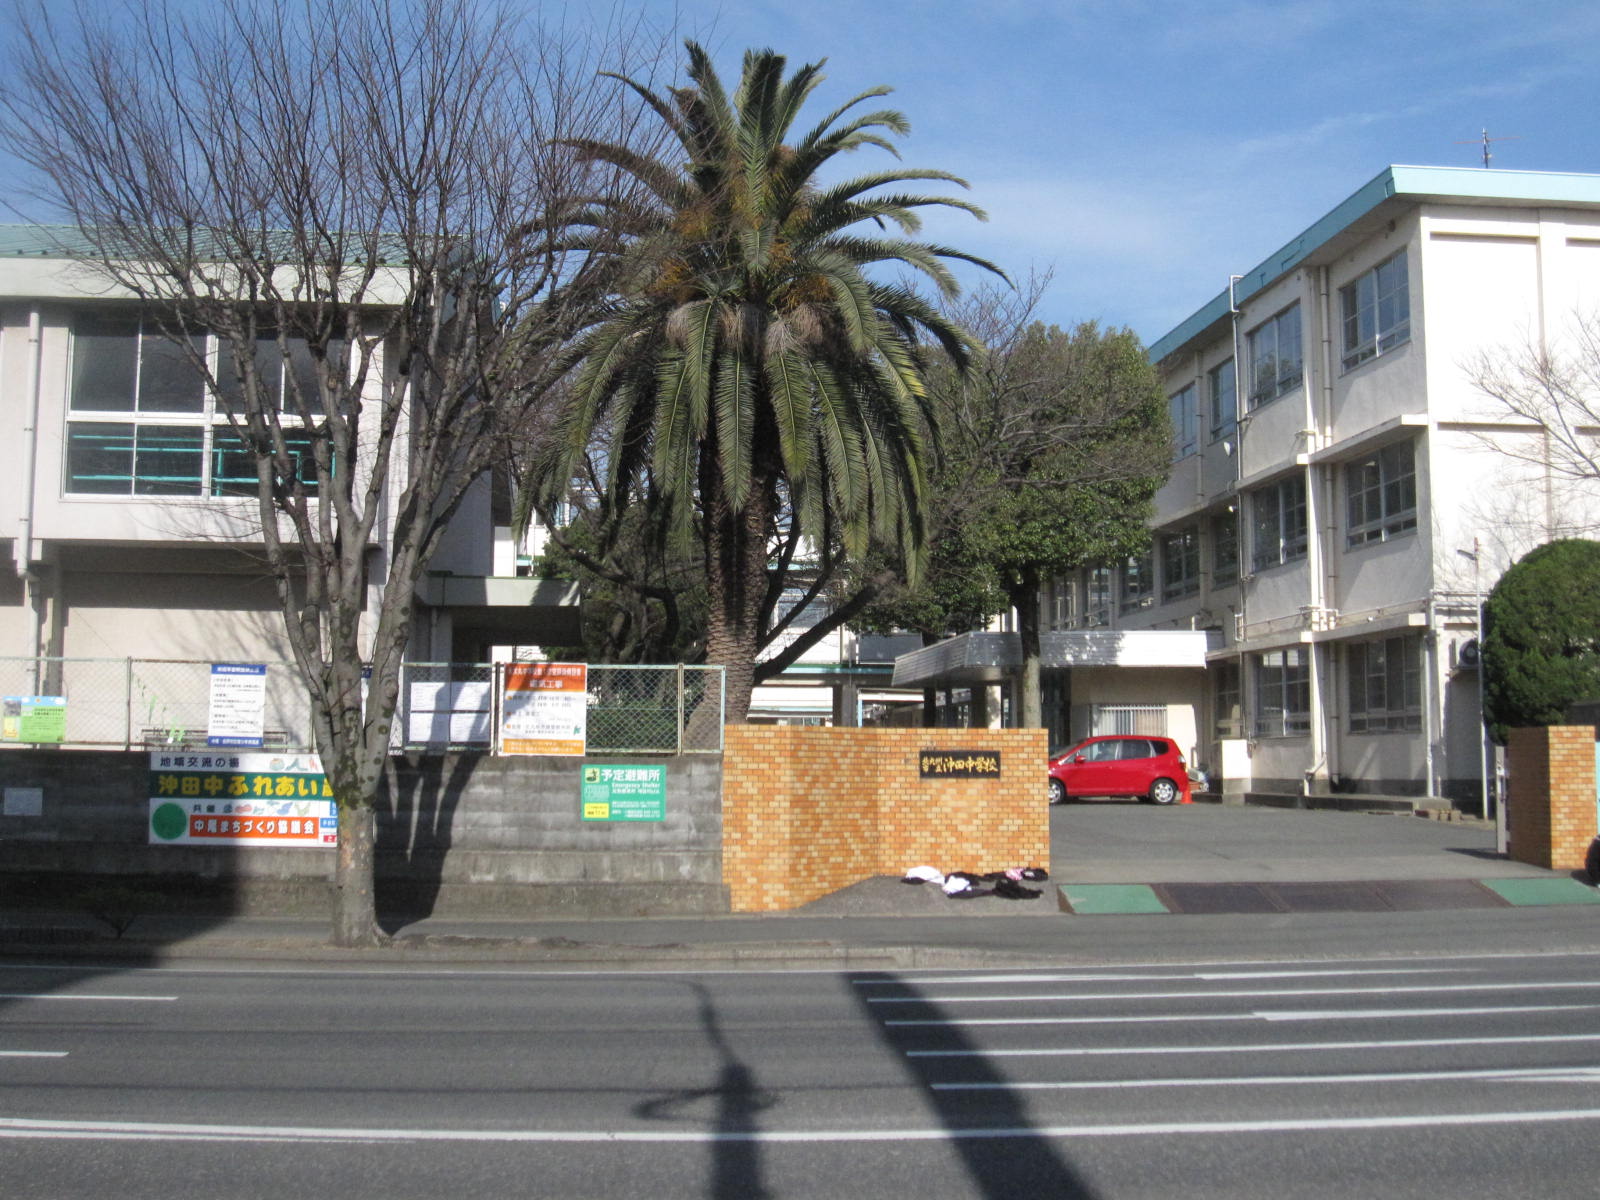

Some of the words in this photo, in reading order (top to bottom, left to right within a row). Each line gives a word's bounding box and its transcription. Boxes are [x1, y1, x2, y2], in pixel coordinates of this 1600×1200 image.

[601, 768, 660, 782] 予定避難所
[194, 818, 314, 834] 中尾まちづくり協議会
